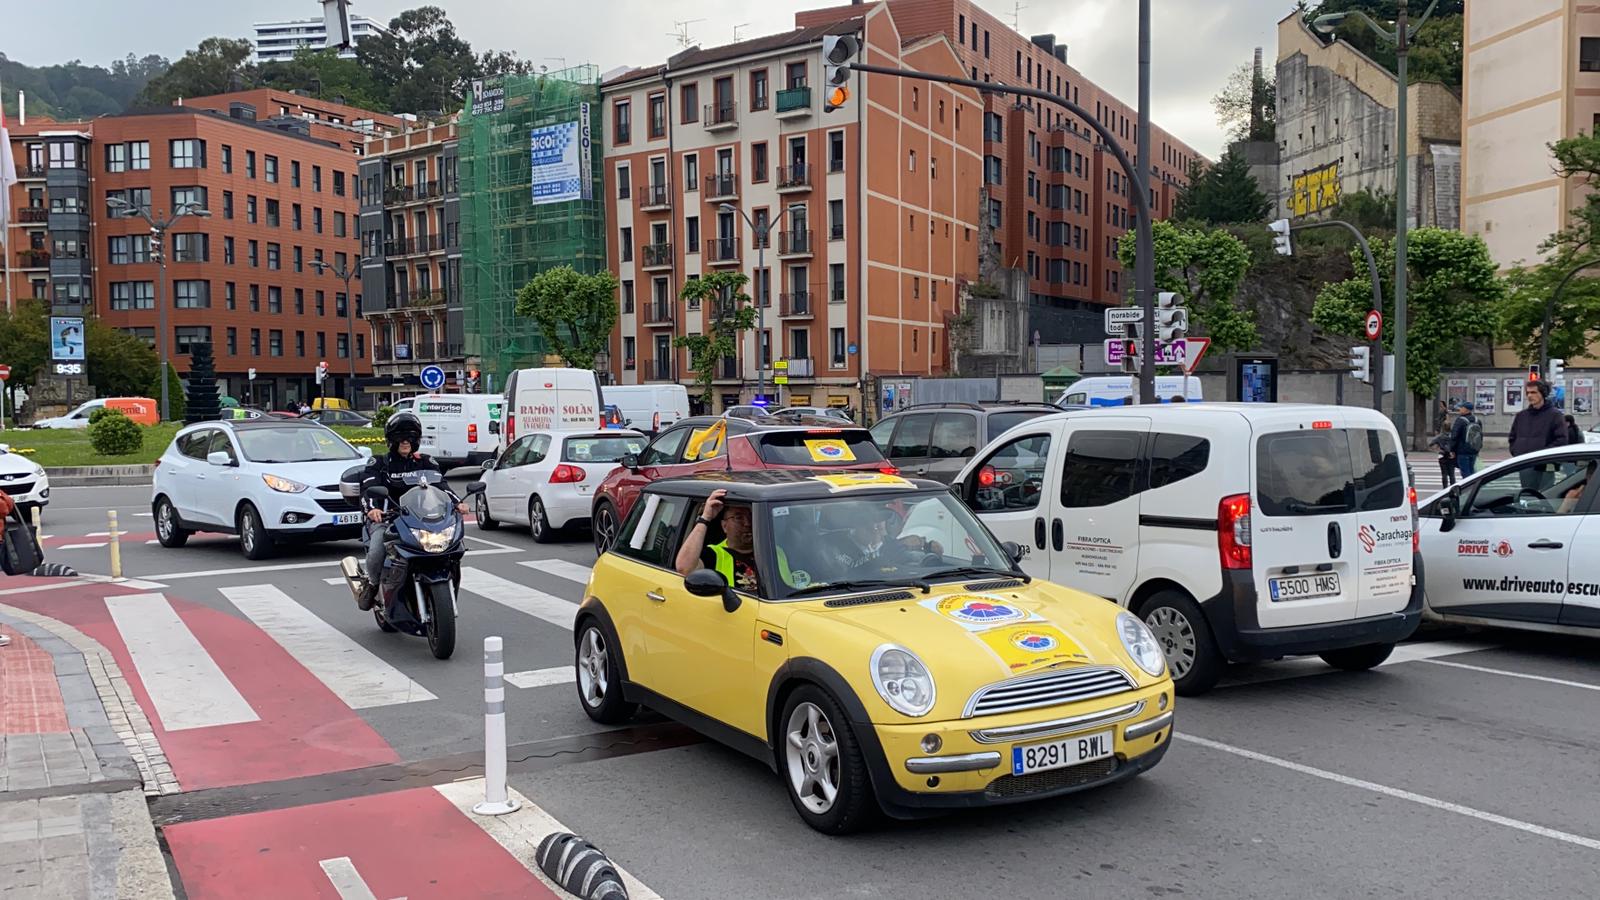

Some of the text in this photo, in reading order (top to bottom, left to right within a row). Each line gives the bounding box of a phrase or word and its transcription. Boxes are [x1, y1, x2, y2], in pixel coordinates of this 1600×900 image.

[1111, 311, 1140, 319] norabide
[56, 364, 81, 374] 9:35
[420, 404, 461, 413] enterprise
[339, 515, 359, 523] 4619
[1376, 529, 1412, 541] Sarachaga
[1458, 545, 1489, 554] DRIVE
[1280, 579, 1310, 597] 5500
[1314, 576, 1336, 593] HMS
[1026, 742, 1067, 769] 8291
[1078, 735, 1109, 760] BWL
